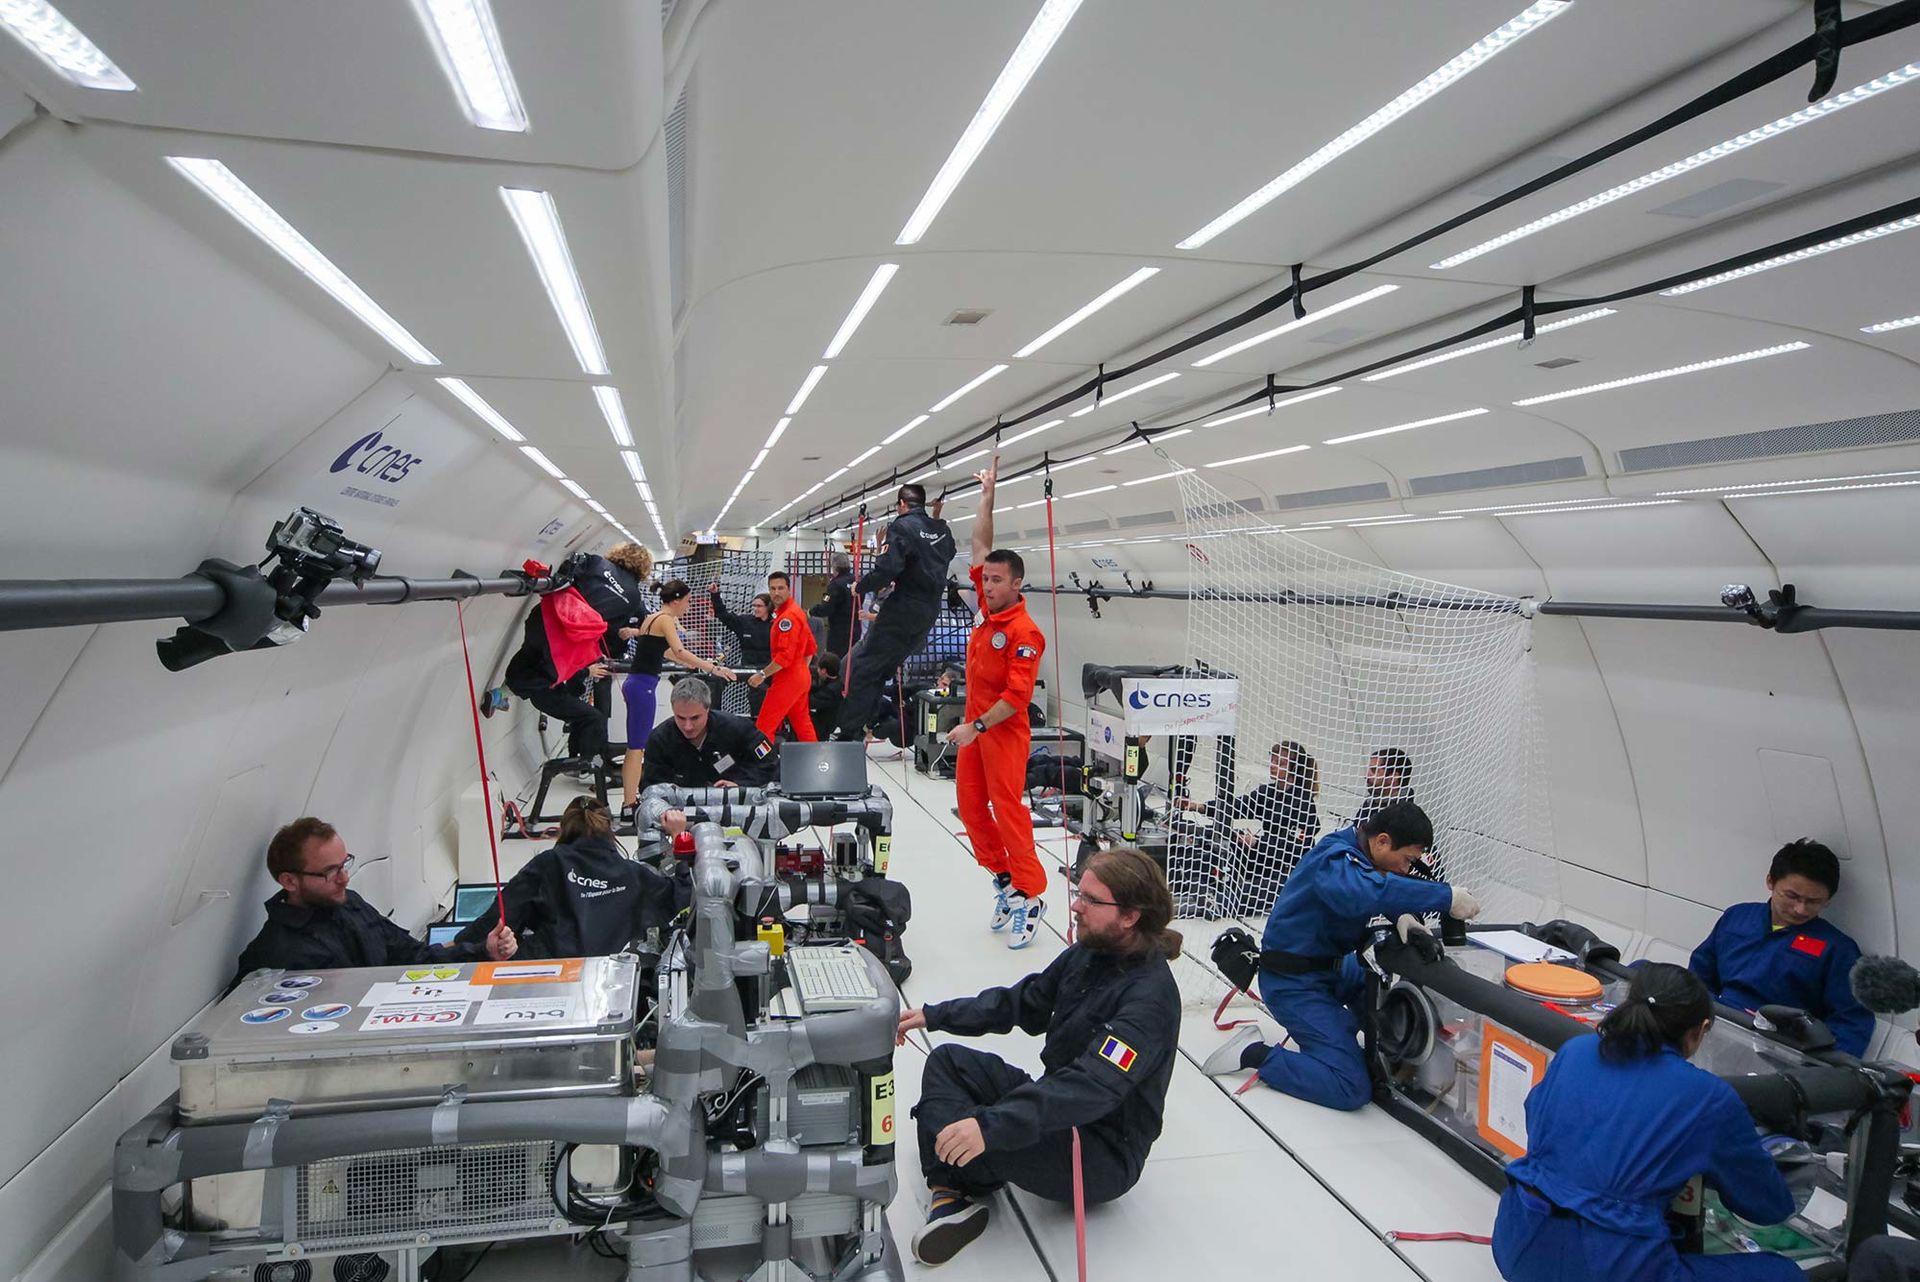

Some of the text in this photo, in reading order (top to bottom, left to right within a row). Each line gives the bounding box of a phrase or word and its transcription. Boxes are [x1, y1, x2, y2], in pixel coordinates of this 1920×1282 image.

[357, 445, 423, 483] cnes
[1153, 693, 1211, 708] cnes
[1127, 749, 1138, 758] E1
[1129, 764, 1136, 774] 5
[577, 876, 608, 889] cnes
[875, 1079, 895, 1100] E3
[881, 1114, 893, 1134] 6
